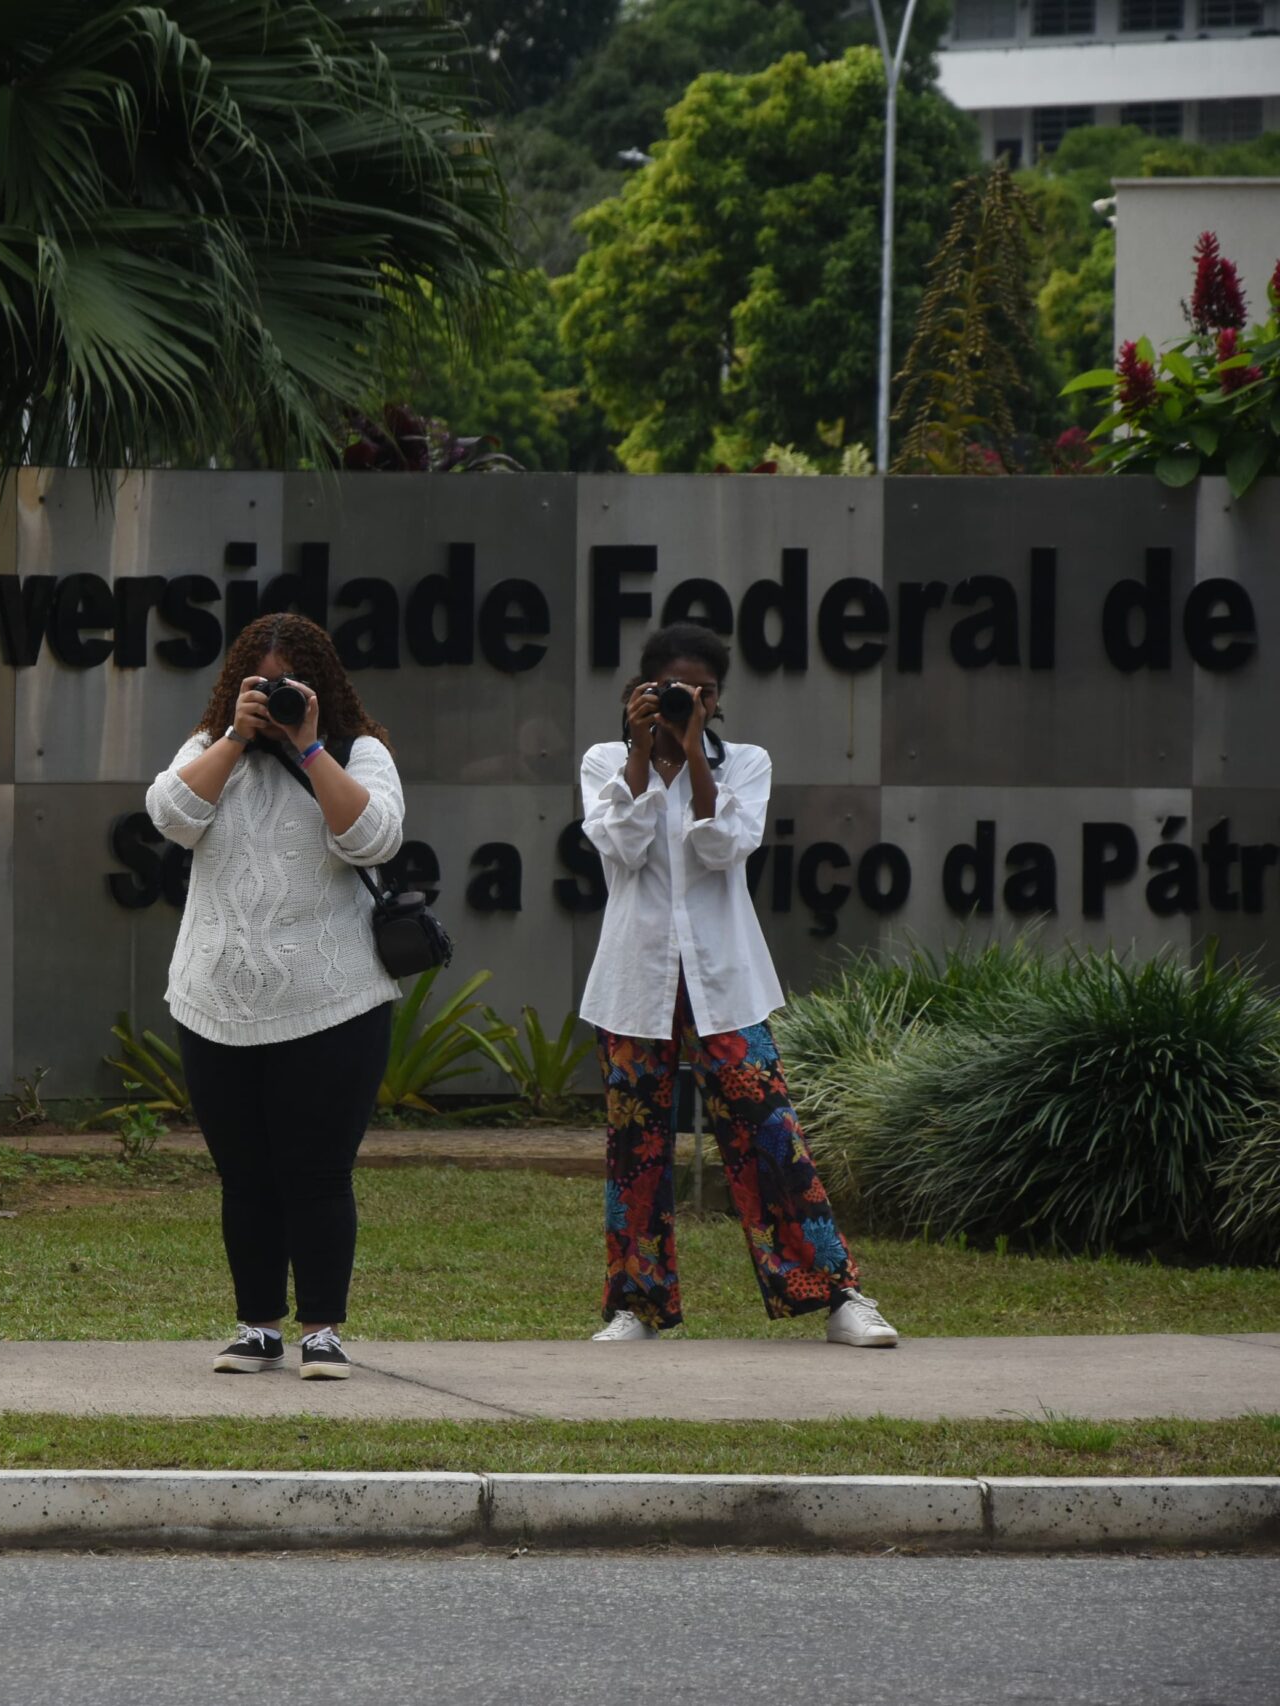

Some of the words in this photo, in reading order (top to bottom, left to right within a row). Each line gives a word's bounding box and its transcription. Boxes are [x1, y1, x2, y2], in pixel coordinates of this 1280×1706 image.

[1102, 547, 1257, 672] de
[465, 841, 522, 911] a
[943, 820, 1057, 916] da
[1082, 816, 1280, 918] Pátr
